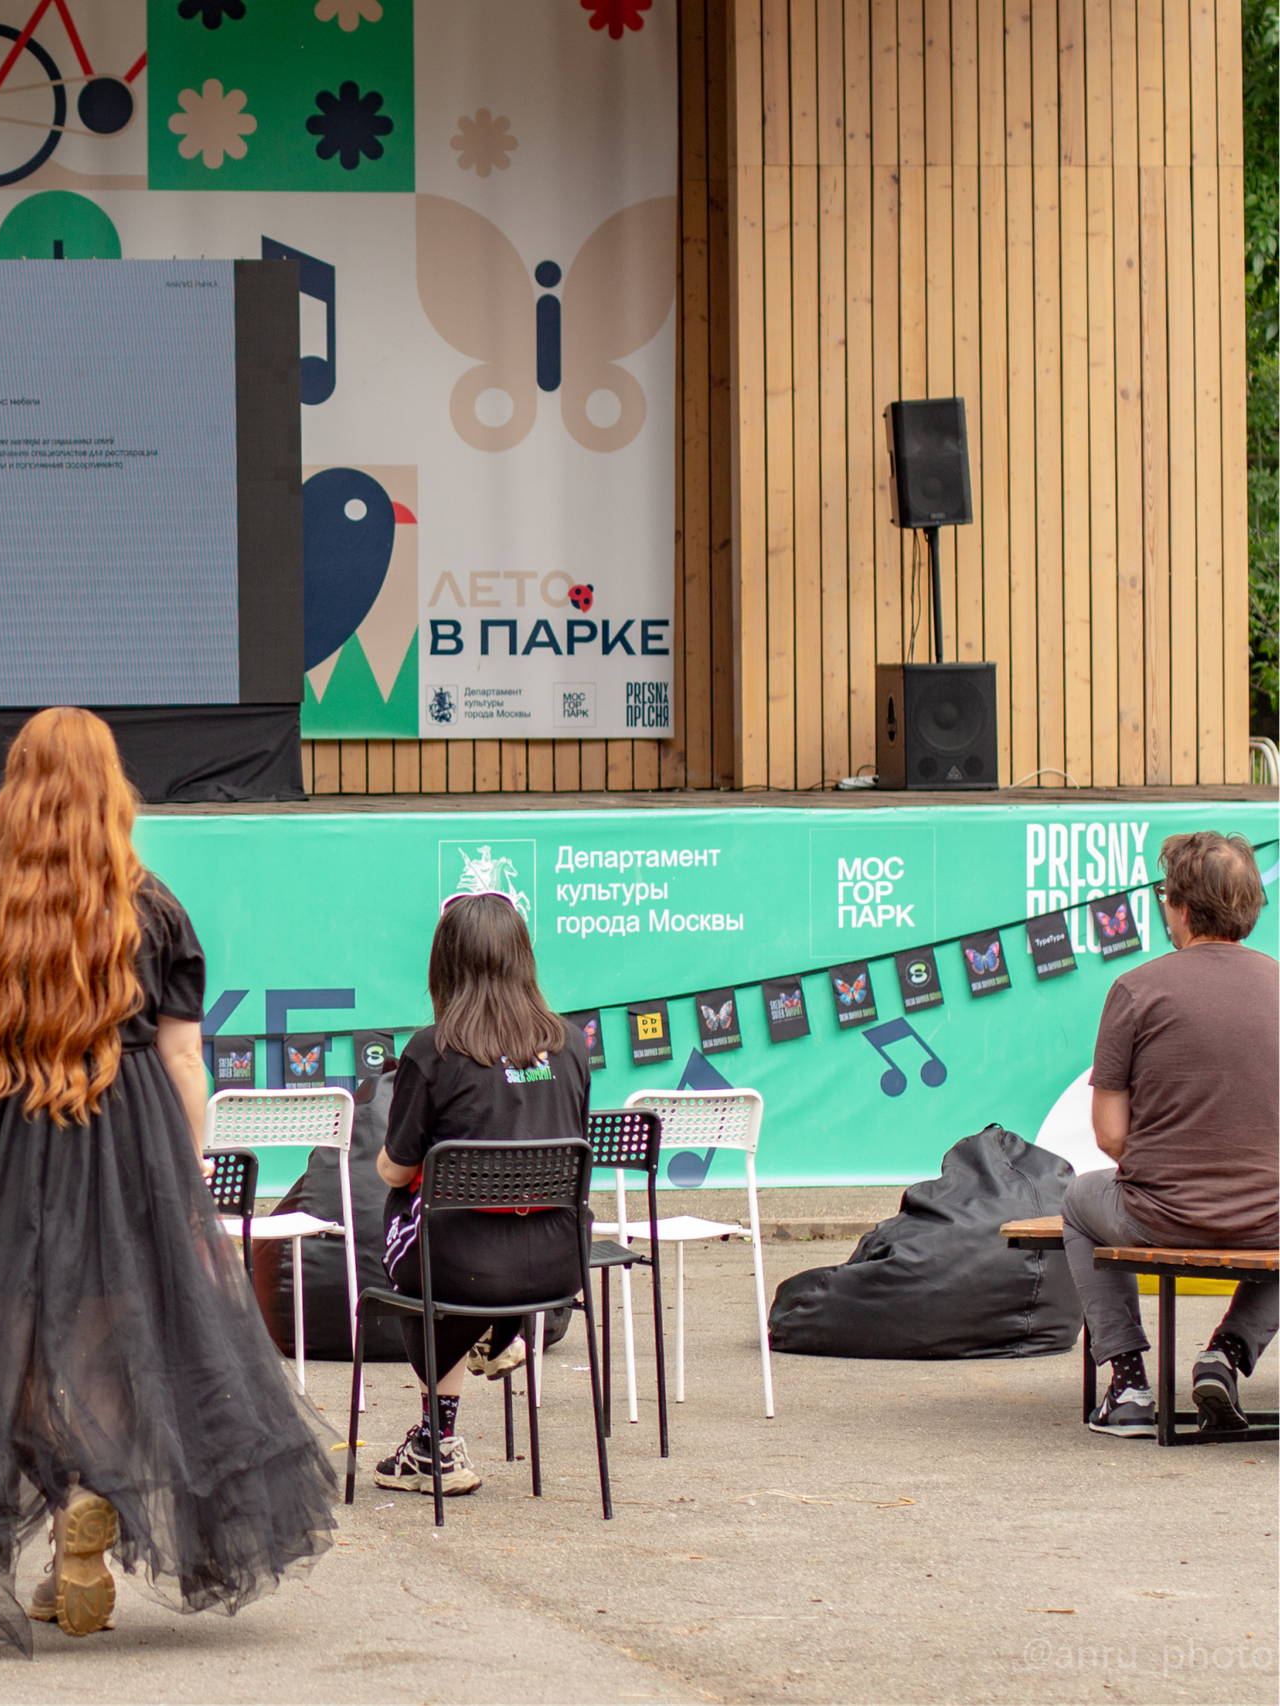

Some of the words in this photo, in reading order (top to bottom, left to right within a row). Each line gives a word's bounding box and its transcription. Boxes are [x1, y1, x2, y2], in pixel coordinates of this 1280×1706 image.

[10, 397, 41, 406] мебели
[31, 450, 87, 459] специалистов
[89, 450, 103, 458] для
[105, 450, 158, 458] реставрации
[15, 462, 64, 470] пополнения
[65, 462, 124, 470] ассортимента
[427, 570, 575, 609] ЛЕТО
[429, 619, 464, 656] В
[480, 619, 670, 656] ПАРКЕ
[464, 687, 523, 697] Департамент
[563, 693, 586, 701] МОС
[464, 699, 504, 708] культуры
[563, 701, 582, 709] ГОР
[464, 710, 494, 719] города
[496, 709, 531, 718] Москвы
[563, 709, 589, 718] ПАРК
[555, 846, 721, 873] Департамент
[837, 856, 905, 881] МОС
[556, 882, 669, 907] культуры
[837, 881, 894, 904] ГОР
[837, 904, 916, 928] ПАРК
[556, 913, 641, 939] города
[648, 909, 744, 933] Москвы
[1035, 933, 1065, 947] TypeType
